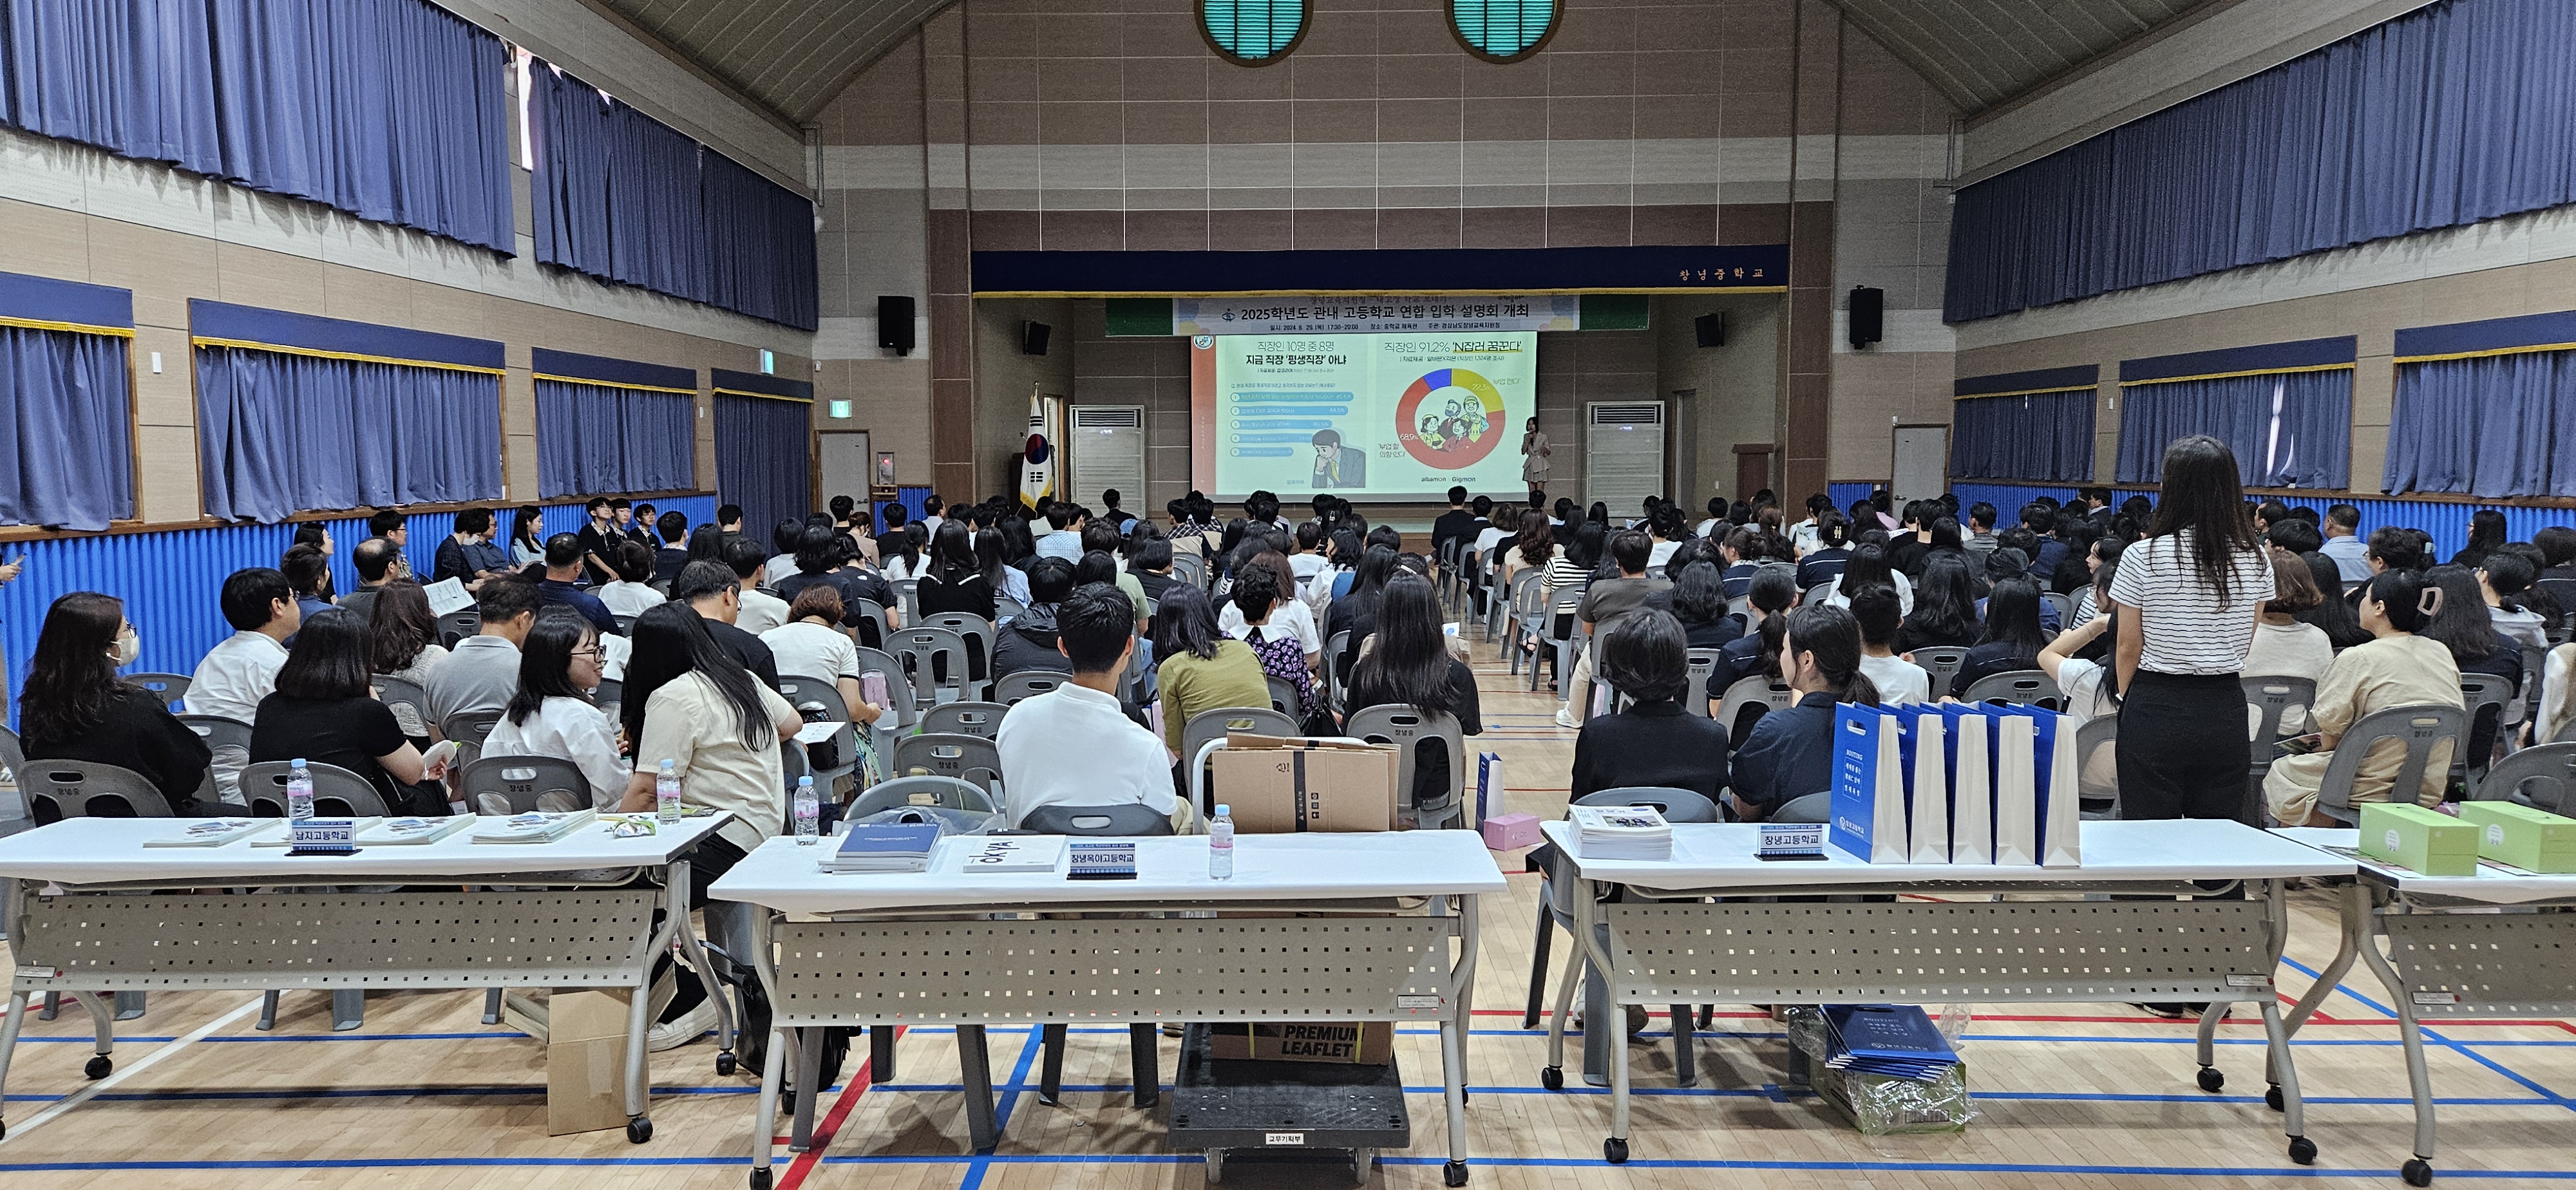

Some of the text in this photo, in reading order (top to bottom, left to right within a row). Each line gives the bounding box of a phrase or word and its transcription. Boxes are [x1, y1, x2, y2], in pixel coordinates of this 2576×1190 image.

[1679, 267, 1763, 281] 창녕중학교
[1241, 303, 1530, 321] 2025학년도 관내 고등학교 연합 입학 설명회 개최
[1257, 341, 1334, 352] 직장인 10명 중 8명
[1385, 342, 1416, 353] 직장인
[1419, 341, 1450, 353] 91.2%
[1245, 355, 1264, 365] 지금
[1265, 355, 1284, 365] 직장
[1328, 355, 1347, 365] 아냐
[57, 788, 80, 796] 창녕중
[296, 831, 348, 840] 남지고등학교
[1765, 835, 1819, 845] 창녕고등학교
[1071, 854, 1134, 864] 창녕옥야고등학교
[1283, 1024, 1365, 1041] PREMIUM
[1281, 1041, 1354, 1058] LEAFLET
